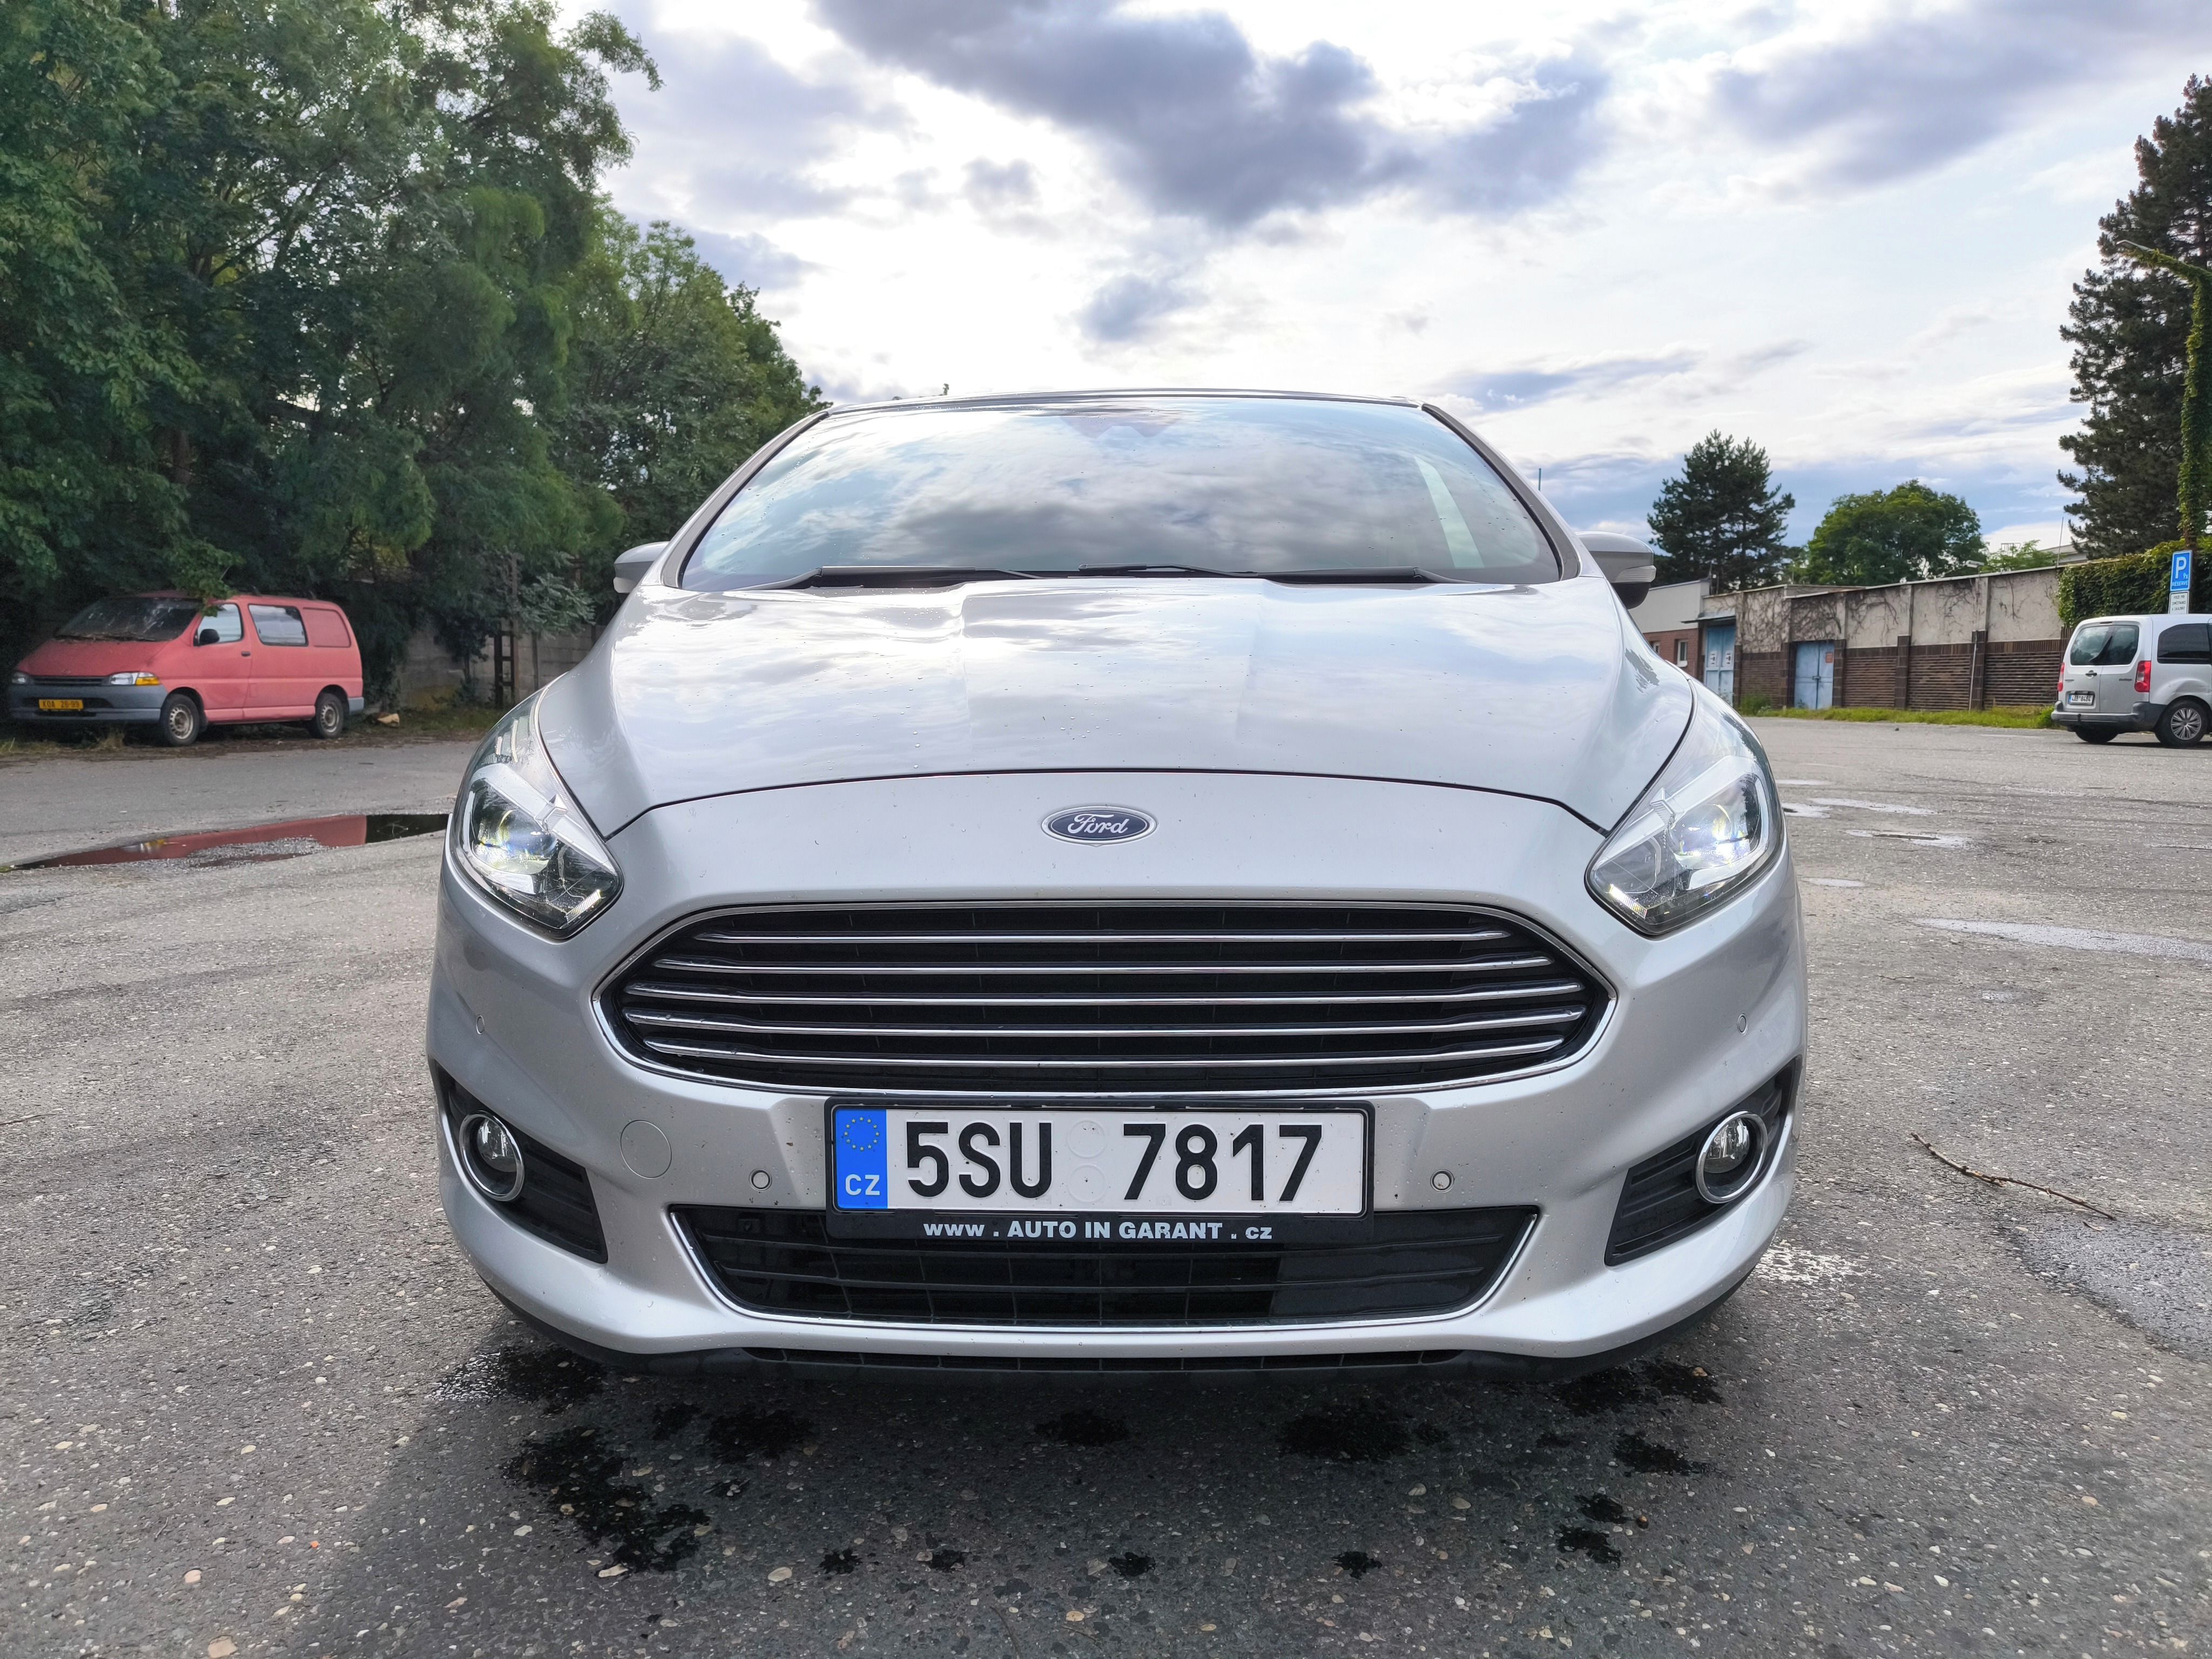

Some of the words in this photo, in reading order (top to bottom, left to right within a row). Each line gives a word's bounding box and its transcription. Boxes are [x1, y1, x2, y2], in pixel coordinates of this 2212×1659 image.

[2175, 556, 2187, 579] P
[1067, 813, 1130, 834] Ford
[906, 1121, 1052, 1198] 5SU
[1123, 1123, 1322, 1202] 7817
[845, 1174, 880, 1196] CZ
[1007, 1220, 1076, 1238] AUTO
[1085, 1222, 1110, 1238] IN
[1118, 1222, 1223, 1239] GARANT
